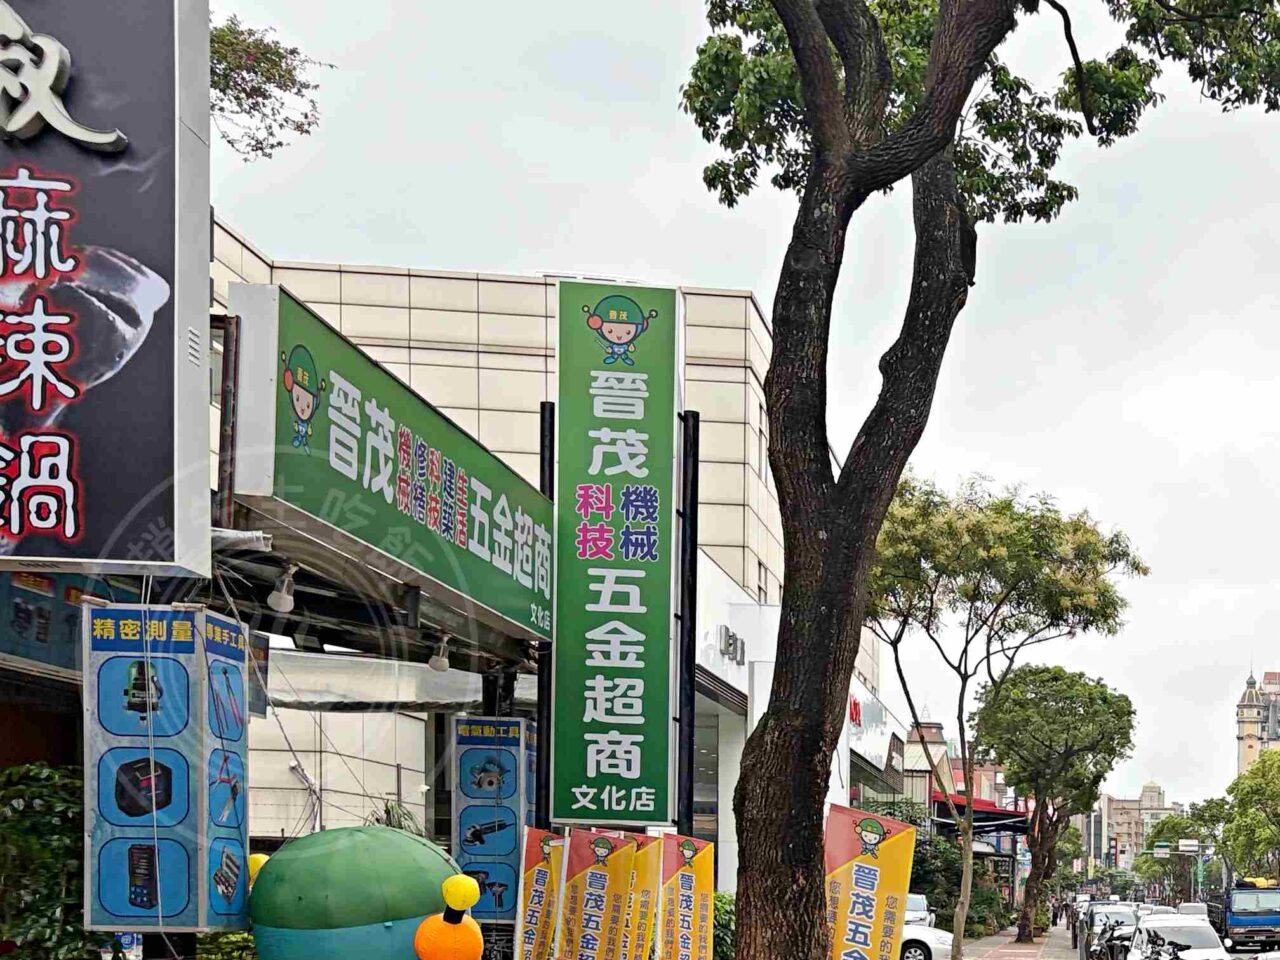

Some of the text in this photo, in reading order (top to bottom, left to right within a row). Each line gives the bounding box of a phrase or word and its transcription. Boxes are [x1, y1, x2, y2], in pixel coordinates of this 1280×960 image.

[327, 368, 394, 505] 晉茂
[588, 369, 650, 478] 晉茂
[468, 477, 551, 600] 五金超商
[575, 483, 615, 560] 科技
[619, 485, 660, 562] 機械
[92, 618, 193, 642] 精密測量
[530, 603, 552, 631] 文化店
[582, 567, 648, 779] 五金超商
[571, 784, 656, 811] 文化店
